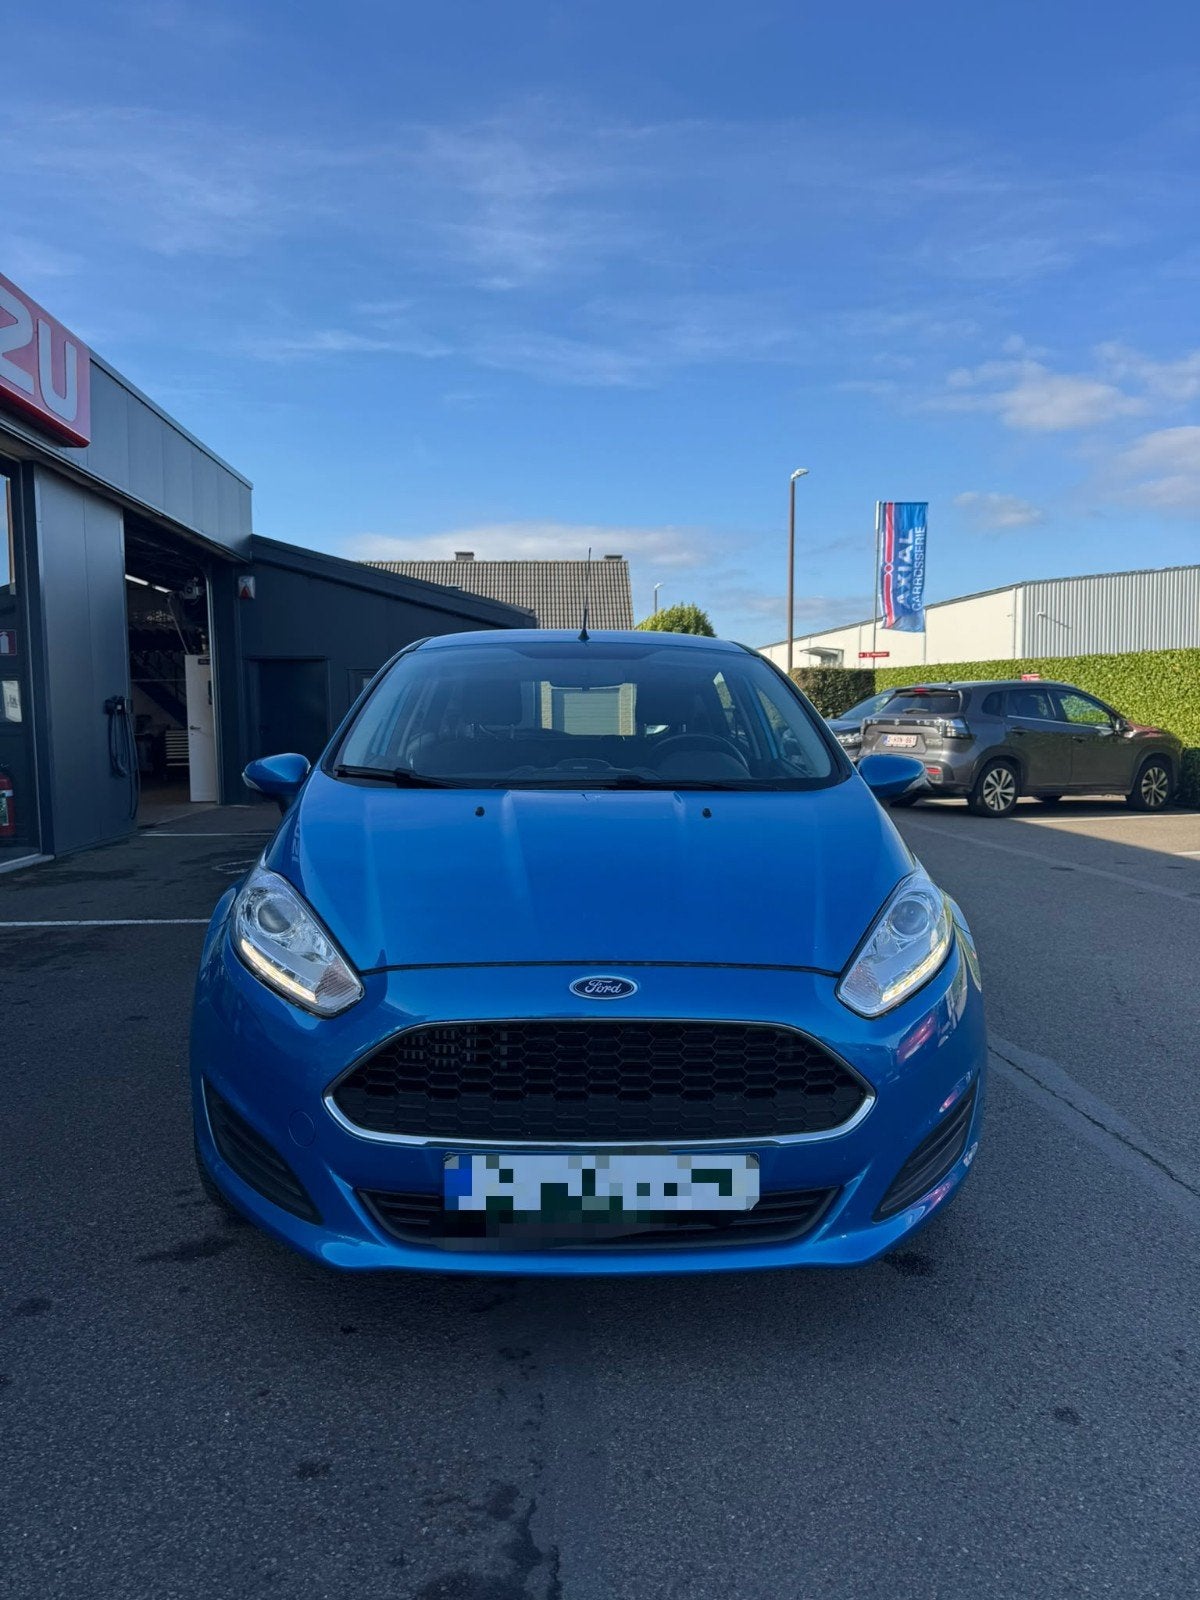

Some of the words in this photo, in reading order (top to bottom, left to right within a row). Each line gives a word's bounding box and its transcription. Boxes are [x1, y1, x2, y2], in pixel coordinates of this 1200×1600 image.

[896, 528, 914, 608] AXIAL
[912, 526, 926, 611] CARROSSERIE
[584, 979, 622, 993] Ford
